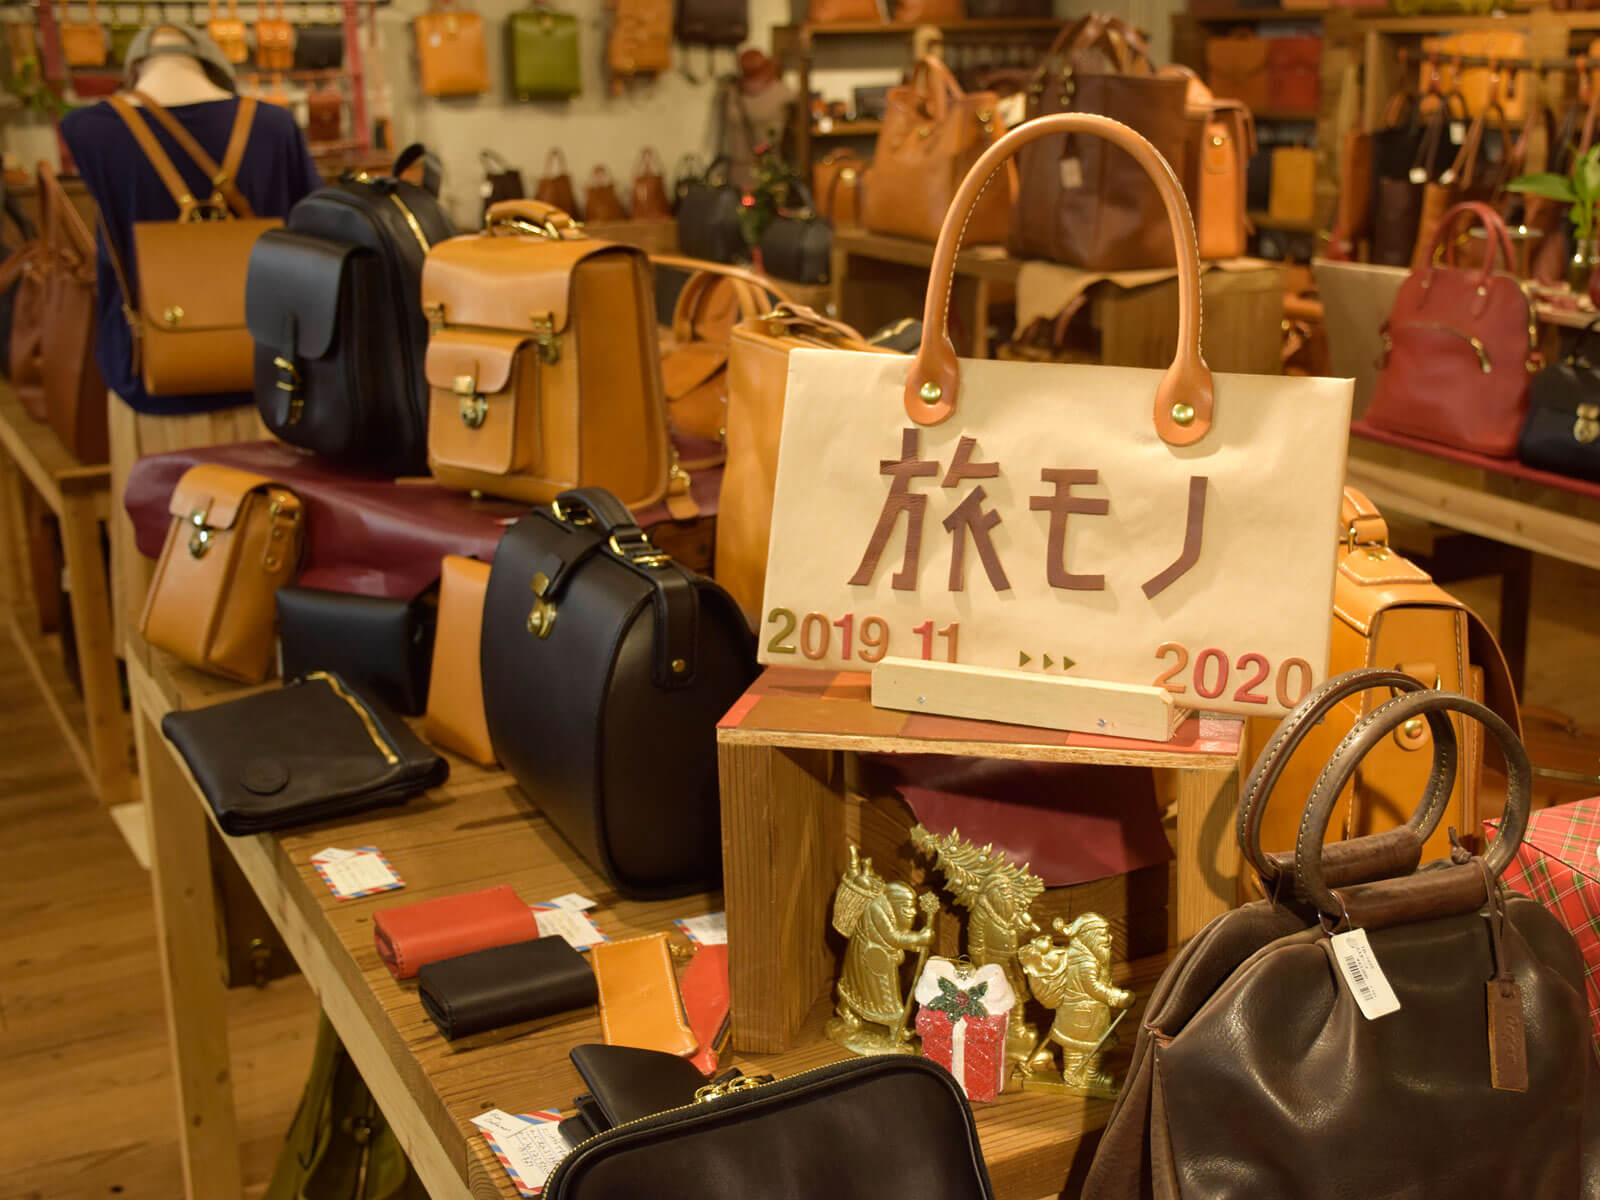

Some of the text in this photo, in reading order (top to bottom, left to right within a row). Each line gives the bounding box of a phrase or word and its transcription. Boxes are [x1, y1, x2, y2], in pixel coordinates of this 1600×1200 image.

[847, 428, 1208, 600] 旅モノ
[767, 607, 1313, 708] 2019 11 2020
